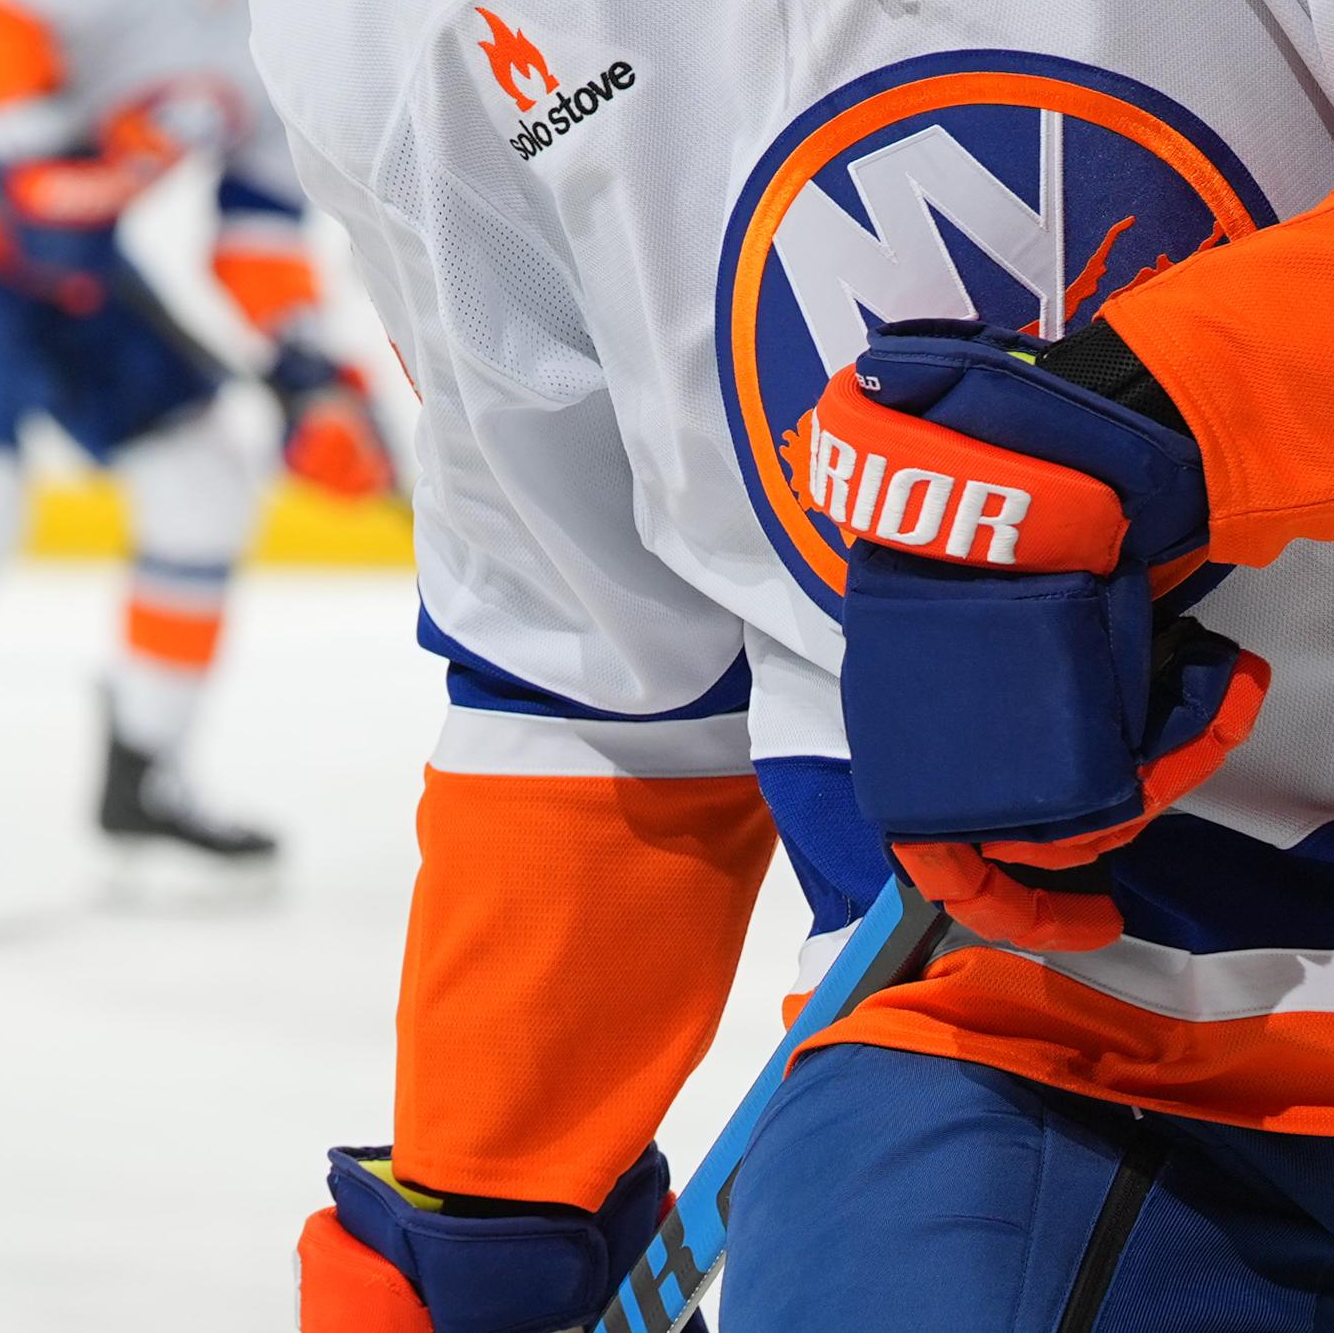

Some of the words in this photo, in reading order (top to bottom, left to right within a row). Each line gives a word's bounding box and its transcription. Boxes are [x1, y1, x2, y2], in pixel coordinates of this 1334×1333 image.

[509, 119, 553, 161] solo
[547, 61, 636, 135] stove
[809, 408, 1032, 565] RIOR
